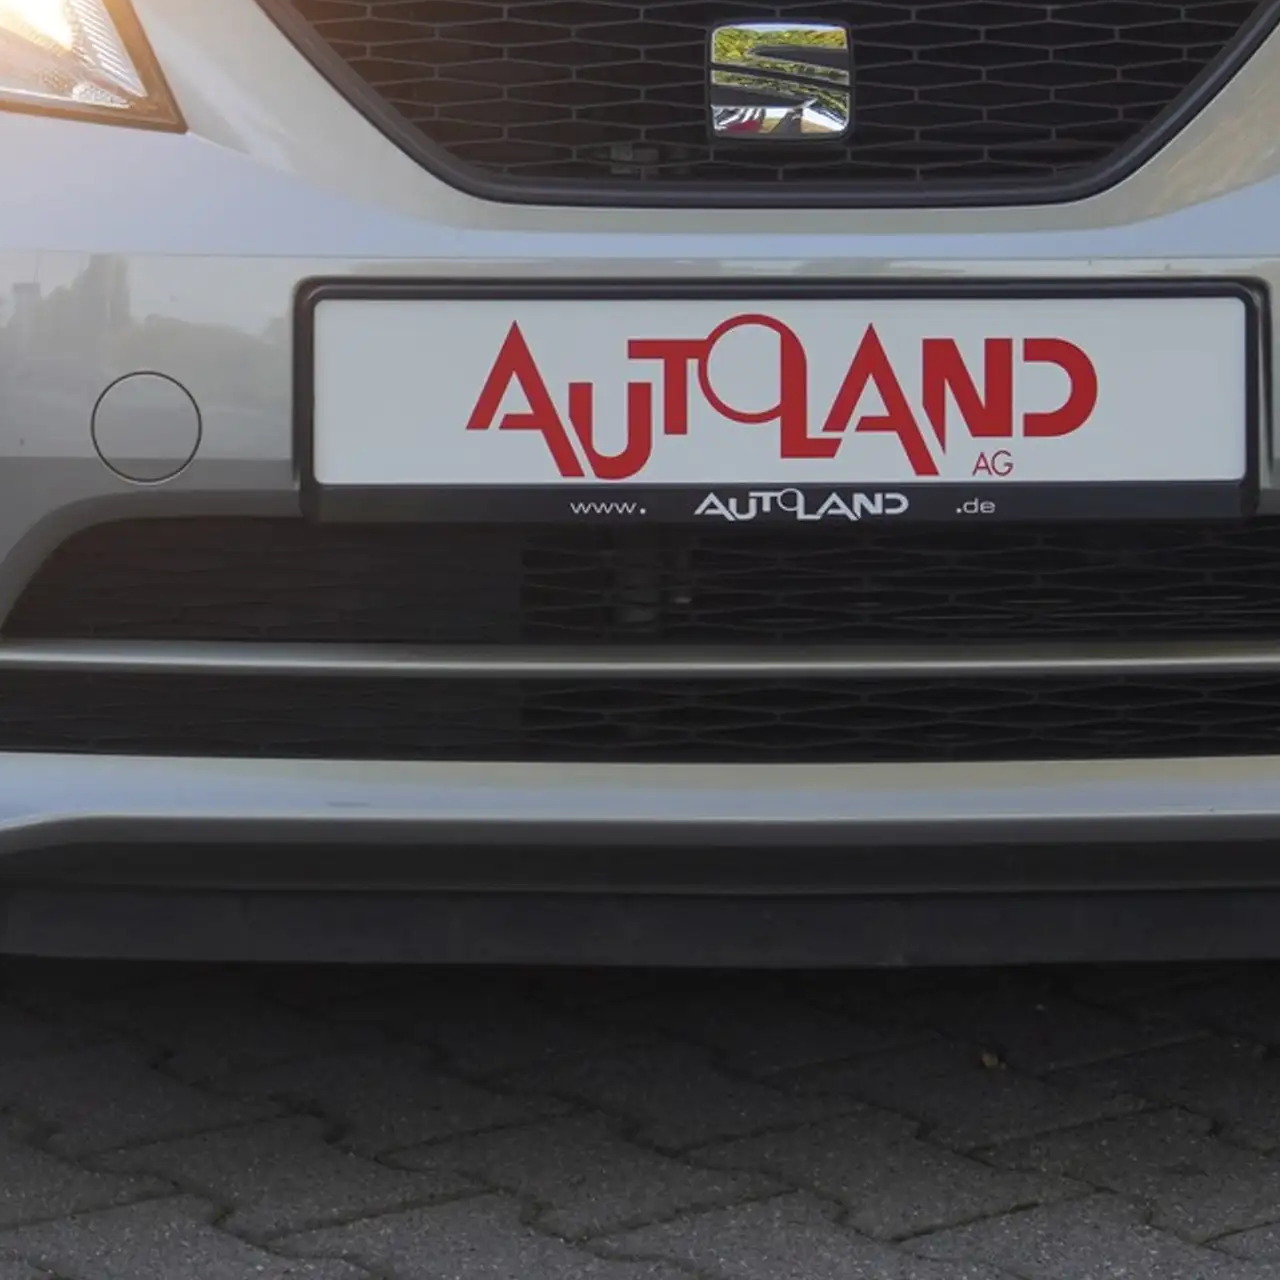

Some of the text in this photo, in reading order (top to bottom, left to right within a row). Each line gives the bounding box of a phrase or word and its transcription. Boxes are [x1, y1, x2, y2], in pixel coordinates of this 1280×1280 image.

[466, 312, 1099, 481] AUTOLAND
[971, 450, 1015, 477] AG
[569, 487, 997, 522] www. AUTOLAND .de
